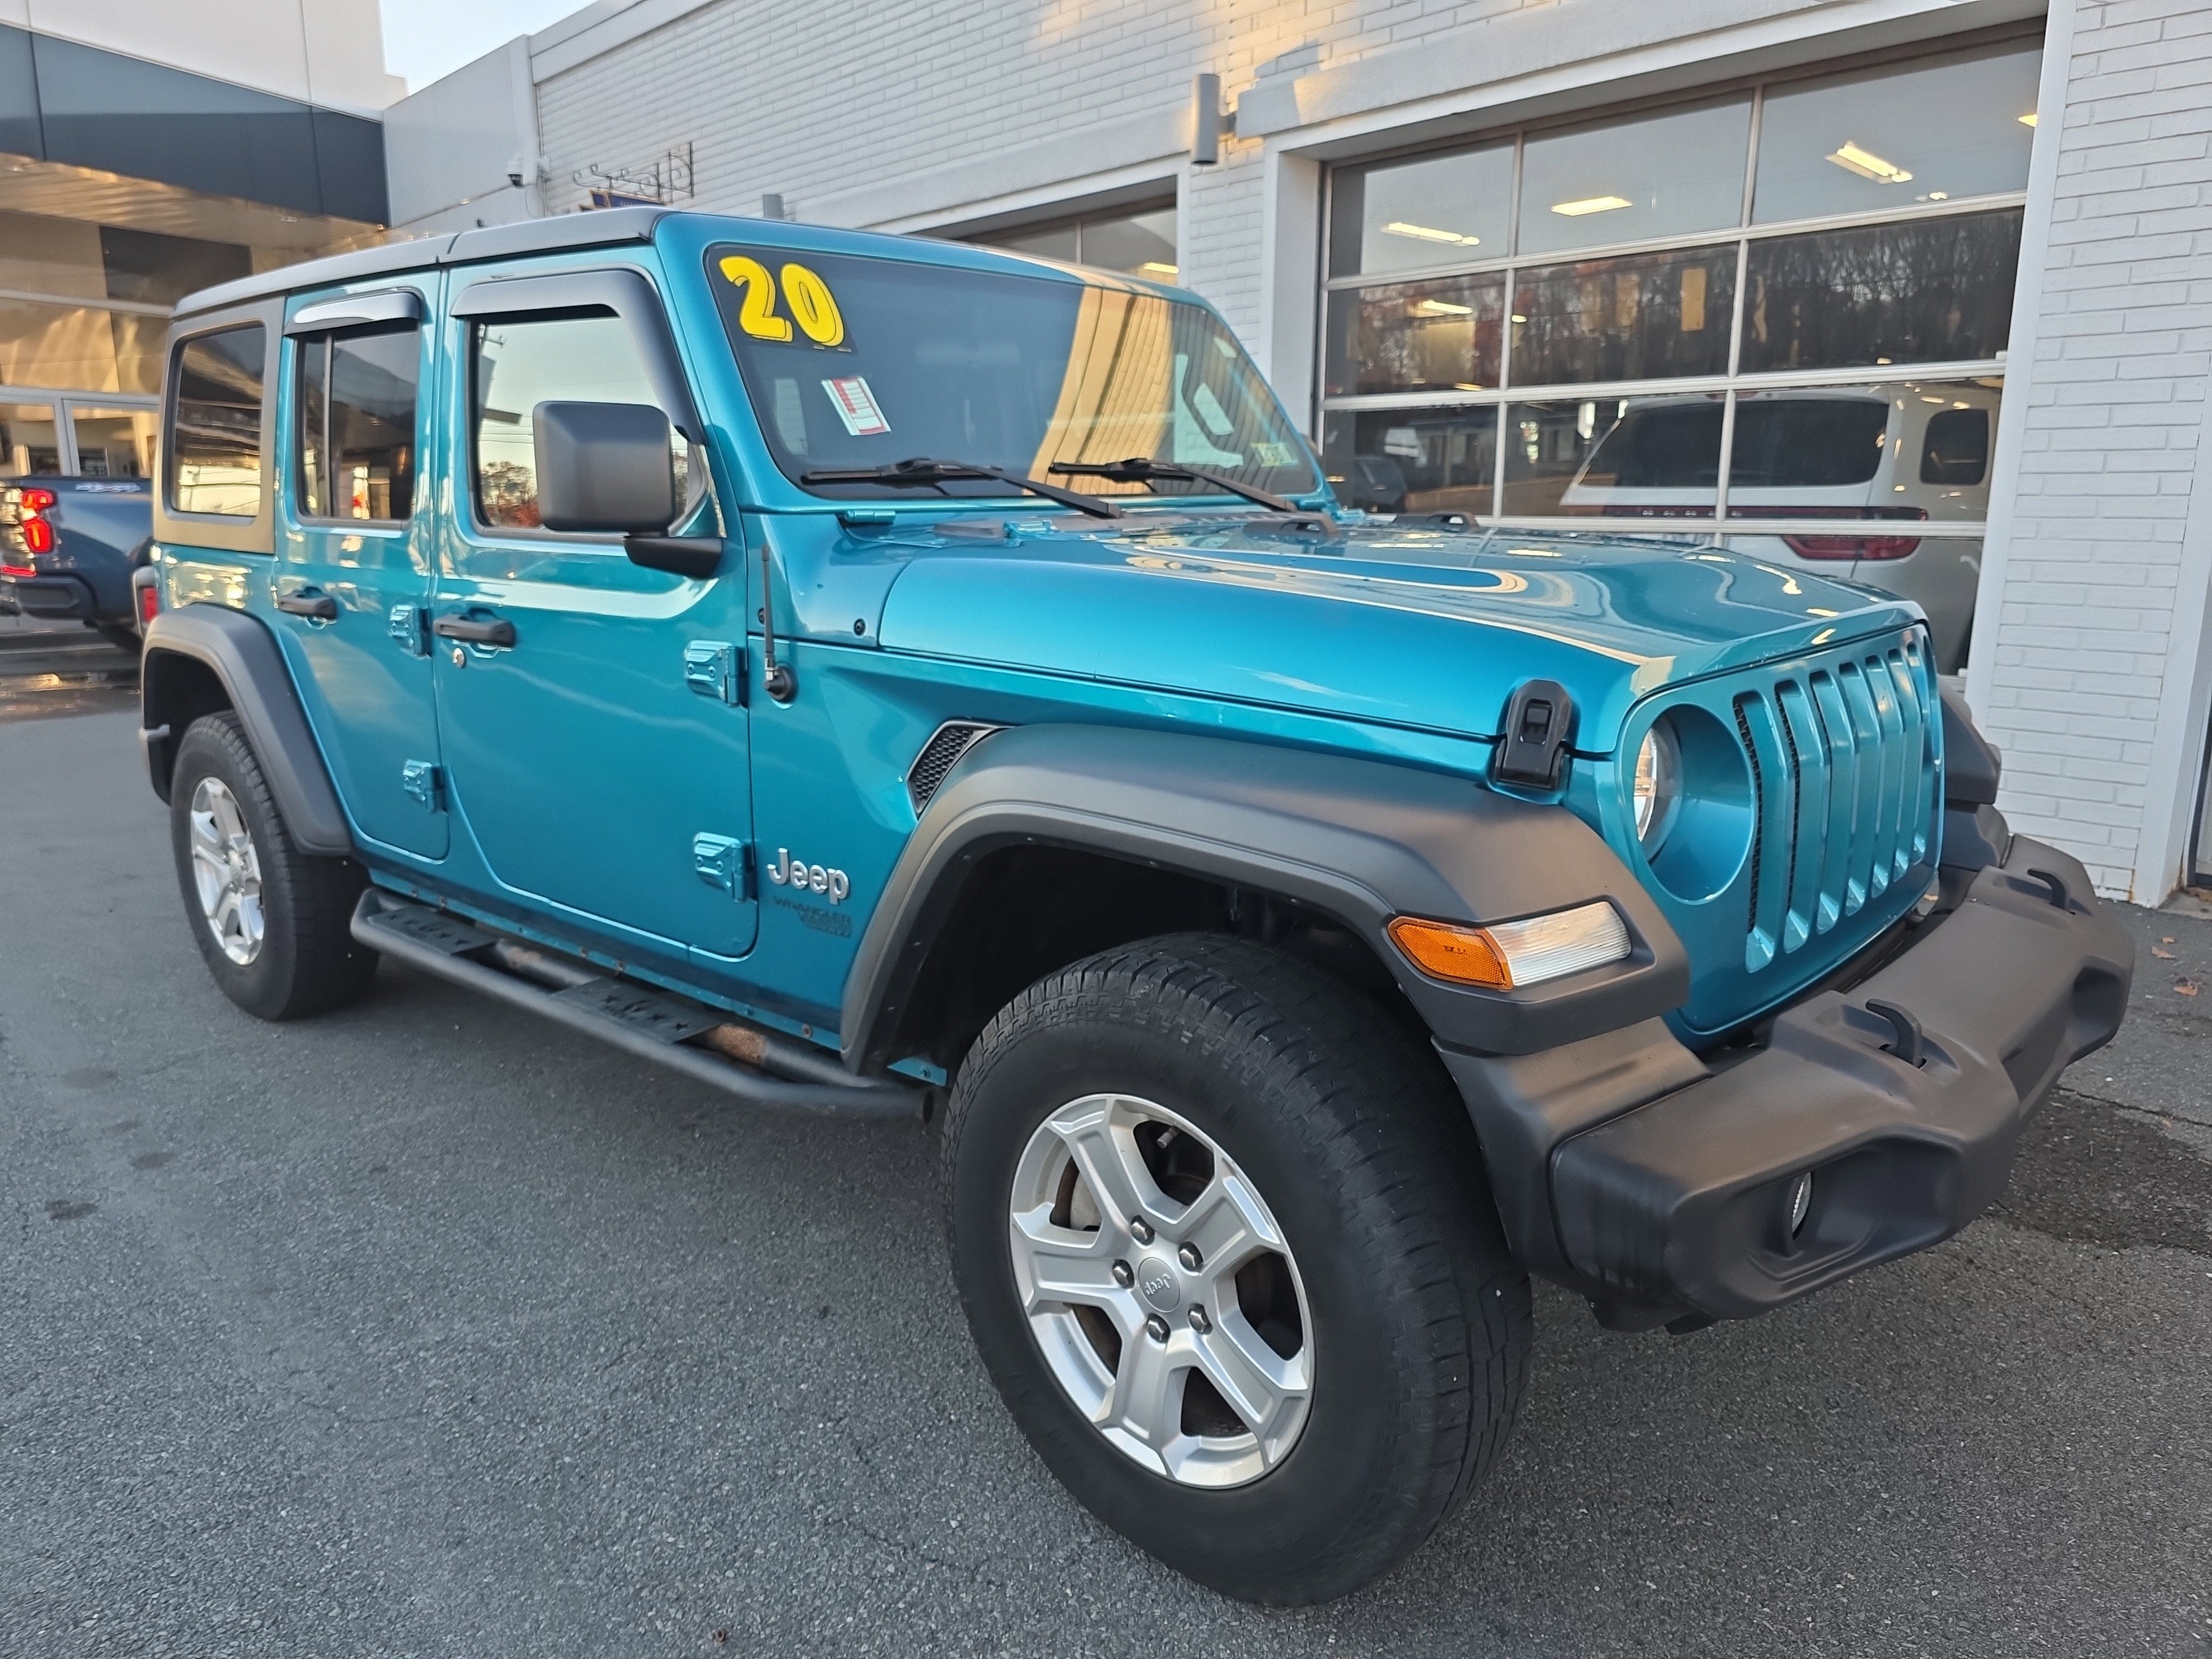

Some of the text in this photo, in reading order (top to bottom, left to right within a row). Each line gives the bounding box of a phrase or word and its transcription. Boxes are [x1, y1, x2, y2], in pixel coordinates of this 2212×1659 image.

[719, 255, 844, 346] 20
[767, 848, 849, 905] Jeep
[1145, 1274, 1171, 1295] Jeep
